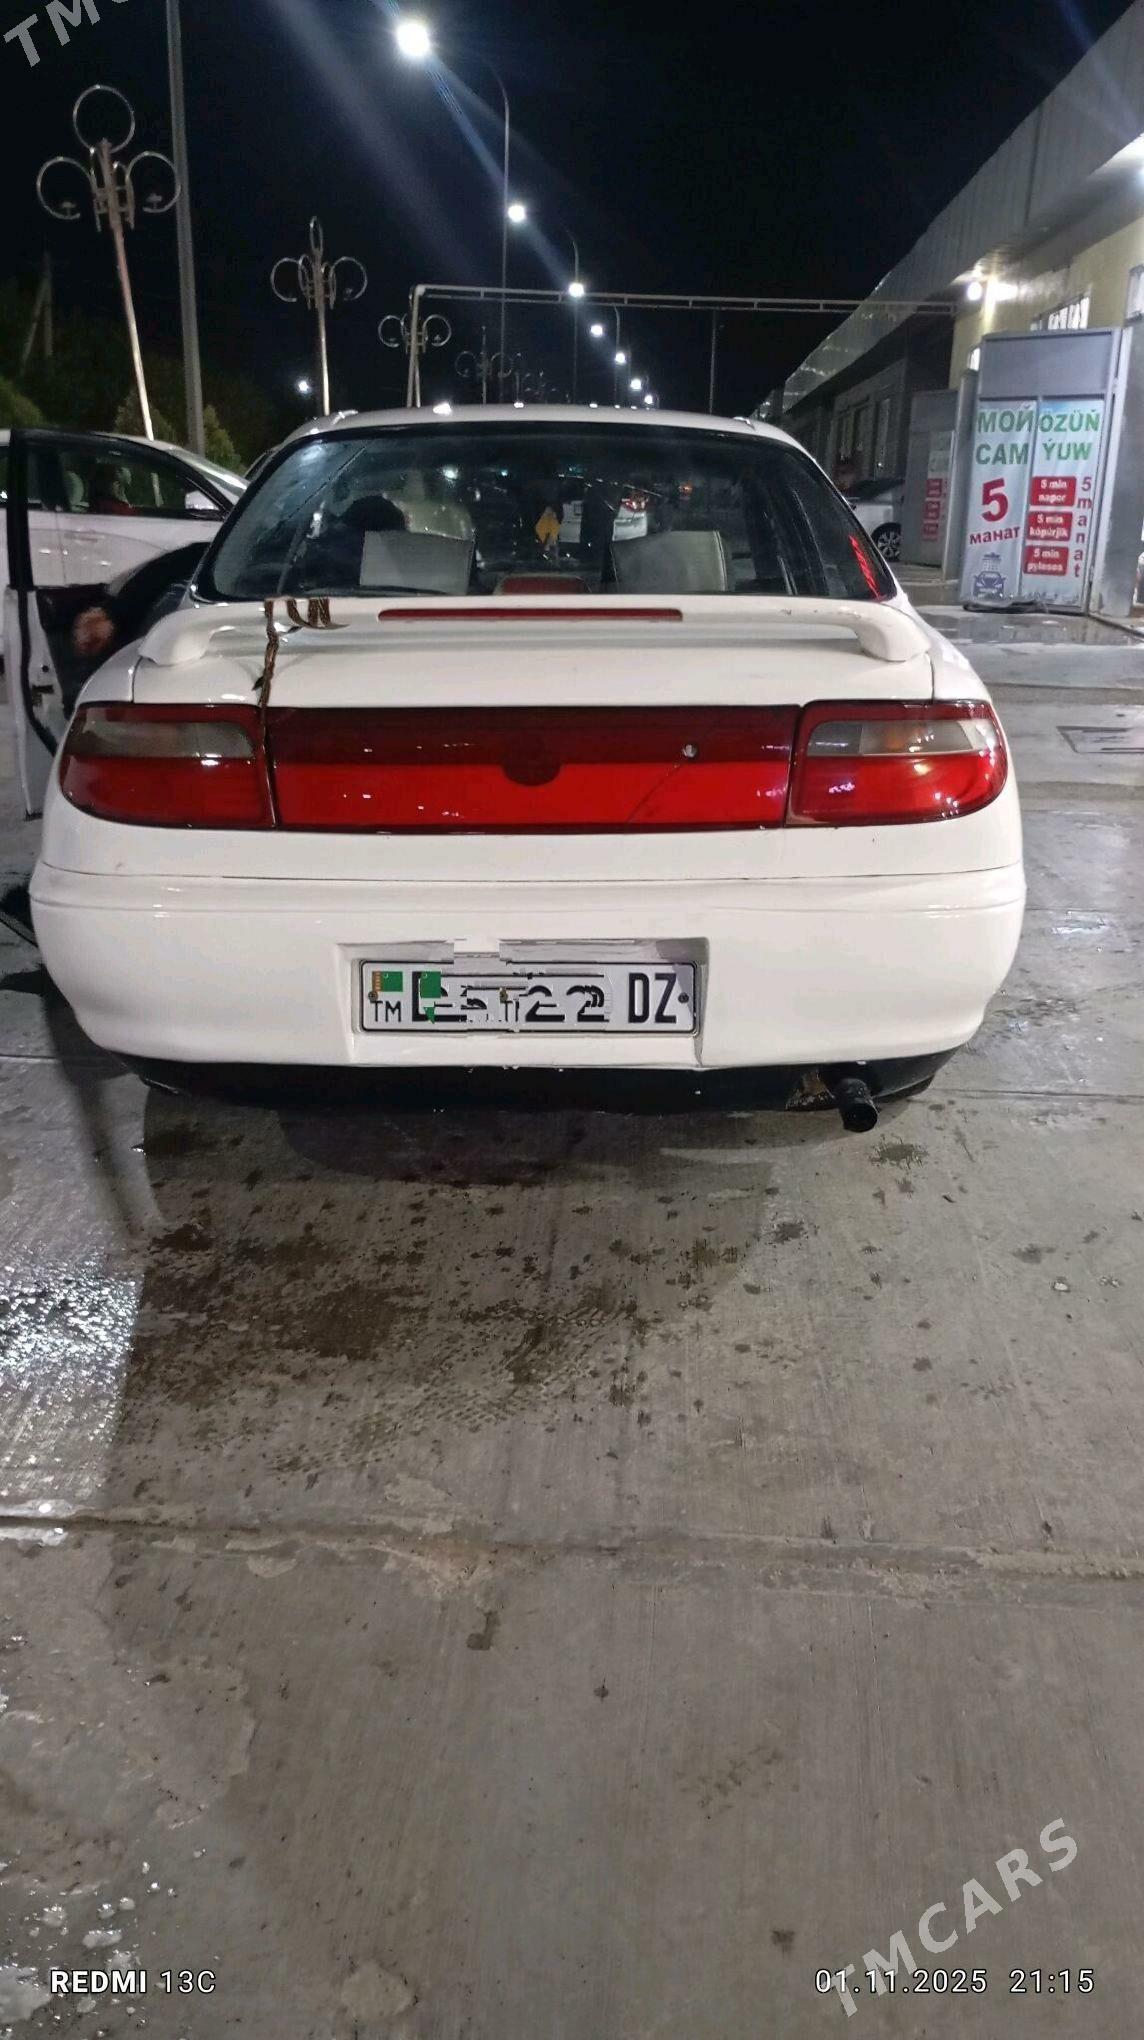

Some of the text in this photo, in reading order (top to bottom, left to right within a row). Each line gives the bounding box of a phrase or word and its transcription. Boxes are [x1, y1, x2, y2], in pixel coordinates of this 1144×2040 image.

[977, 405, 1035, 432] МОЙ
[975, 443, 1029, 465] САМ
[1042, 438, 1093, 460] ÝUW
[1049, 479, 1067, 489] min
[1081, 477, 1092, 491] 5
[982, 478, 1008, 521] 5
[970, 526, 1020, 544] манат
[1042, 549, 1059, 557] min
[371, 1001, 401, 1022] TM
[628, 972, 677, 1023] DZ
